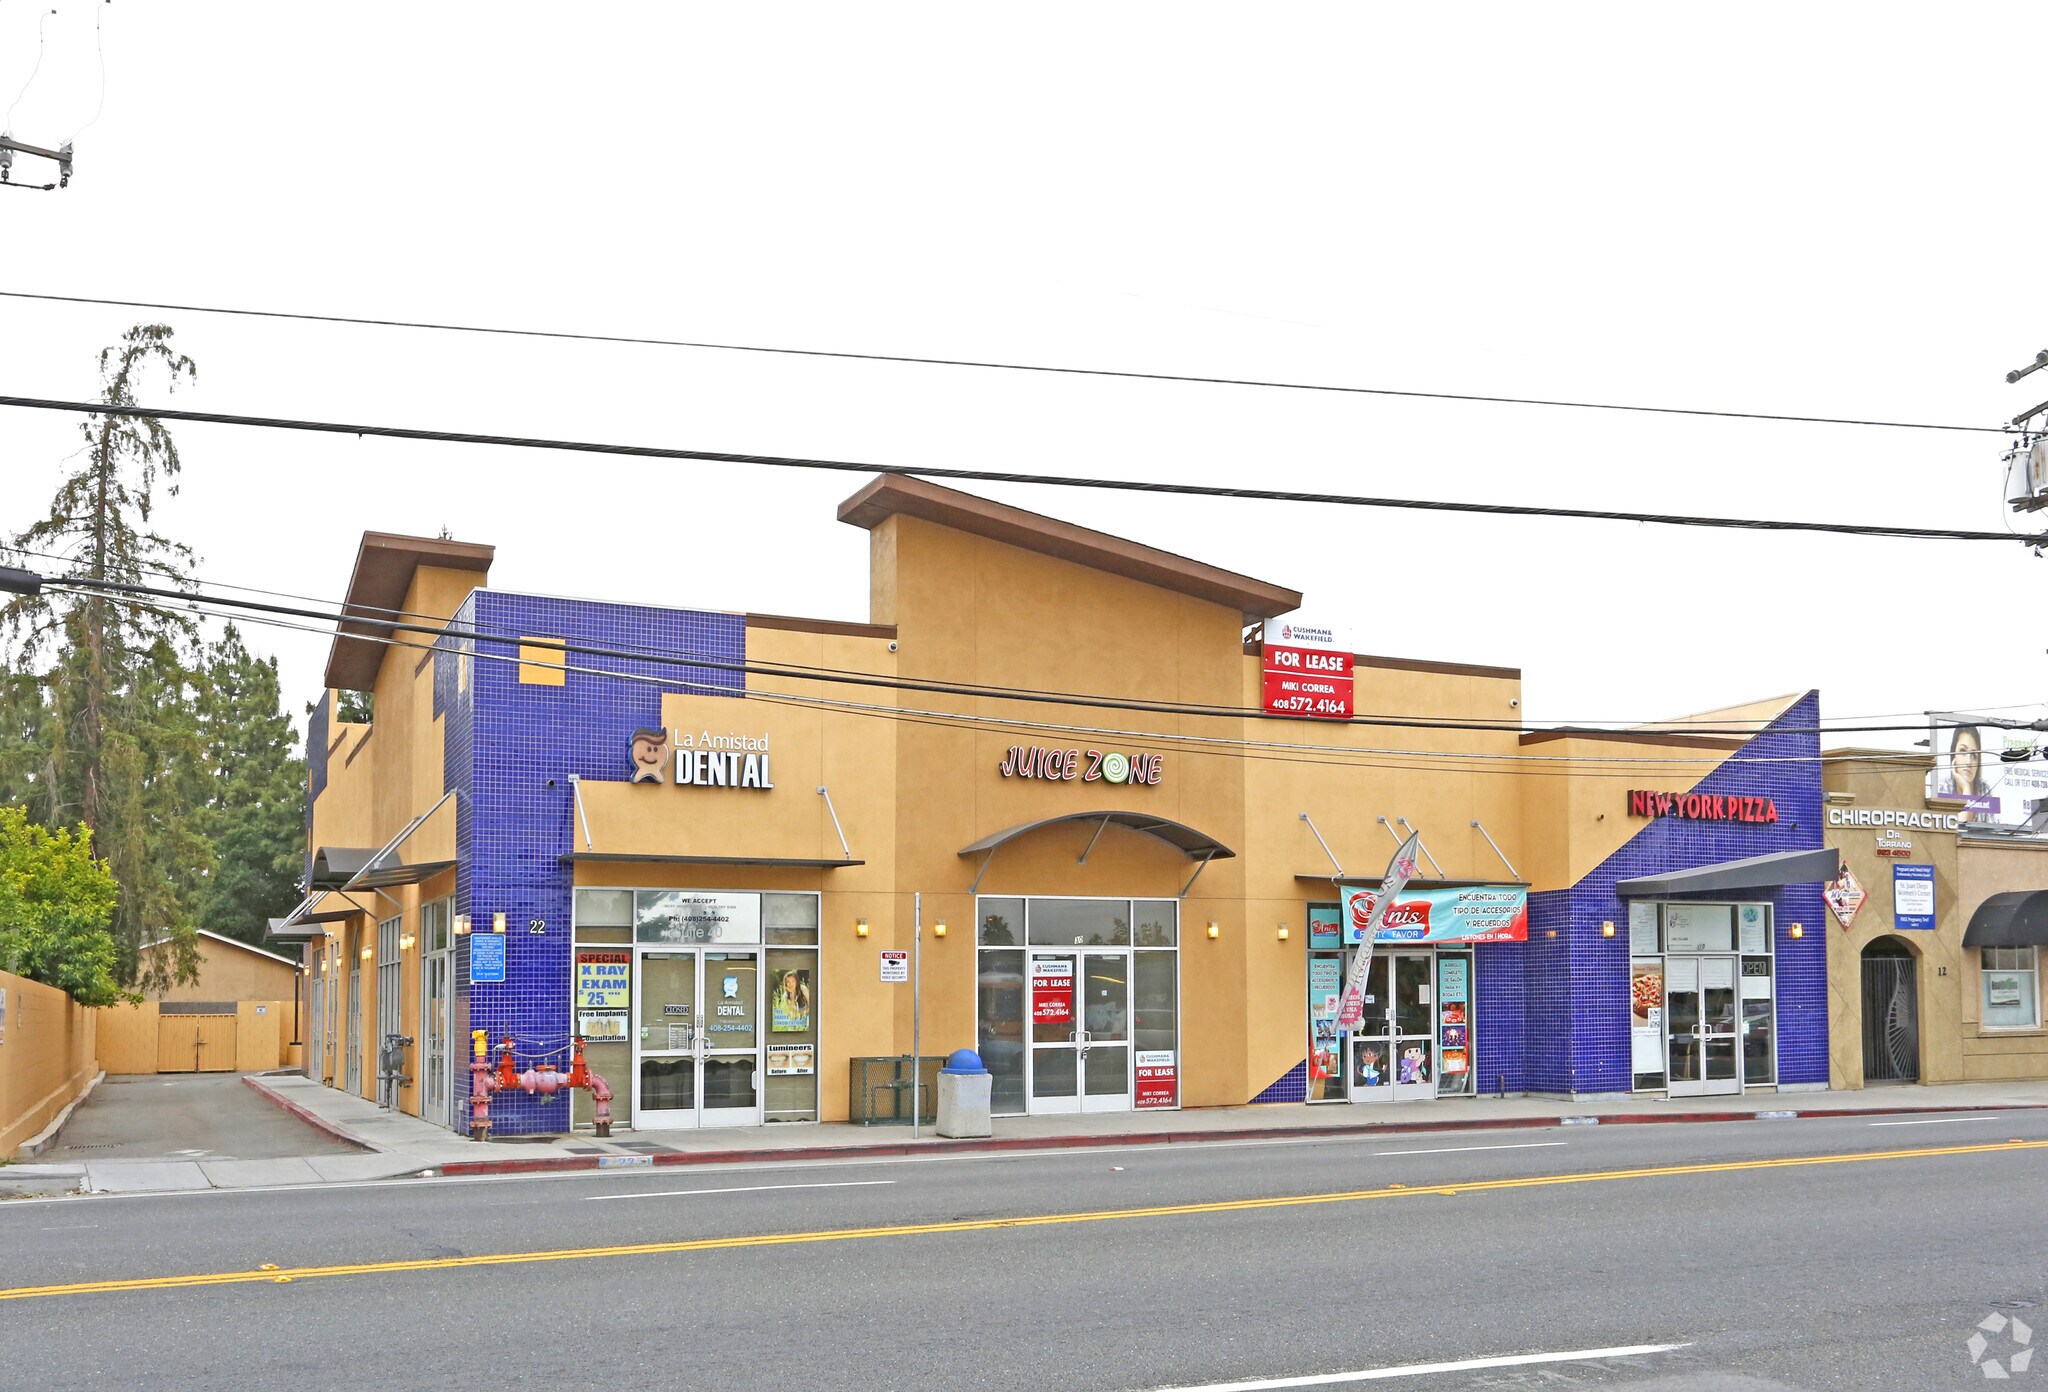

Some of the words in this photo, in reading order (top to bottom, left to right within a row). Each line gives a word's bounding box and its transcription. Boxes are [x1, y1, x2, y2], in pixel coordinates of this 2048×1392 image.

[1293, 633, 1334, 643] WAKEFIELD
[1274, 651, 1301, 667] FOR
[1305, 654, 1344, 671] LEASE
[1281, 681, 1299, 691] MIKI
[1301, 683, 1335, 694] CORREA
[674, 728, 694, 747] La
[698, 729, 769, 751] Amistad
[1000, 745, 1079, 781] JUICE
[674, 748, 775, 790] DENTAL
[1628, 789, 1671, 817] NEW
[1675, 792, 1725, 821] YORK
[1727, 795, 1779, 823] PIZZA
[1828, 808, 1959, 830] CHIROPRACTIC
[1458, 893, 1497, 902] ENCUENTRA
[1499, 893, 1517, 901] TODO
[1453, 906, 1470, 915] TIPO
[1482, 906, 1522, 914] ACCESORIOS
[681, 915, 730, 923] (408)254-4402
[1465, 920, 1471, 928] Y
[1472, 919, 1511, 928] RECUERDOS
[529, 919, 546, 934] 22
[1359, 930, 1386, 939] PTY
[1391, 930, 1419, 939] FAVOR
[580, 953, 627, 963] SPECIAL
[581, 965, 592, 975] X
[596, 965, 627, 975] RAY
[1742, 962, 1767, 974] OPEN
[1938, 967, 1947, 976] 12
[581, 979, 627, 989] EXAM
[1033, 979, 1048, 987] FOR
[1050, 978, 1071, 987] LEASE
[596, 1010, 628, 1018] Implants
[717, 1005, 745, 1016] DENTAL
[709, 1024, 753, 1032] 408-254-4402
[1138, 1069, 1152, 1077] FOR
[1154, 1068, 1174, 1076] LEASE
